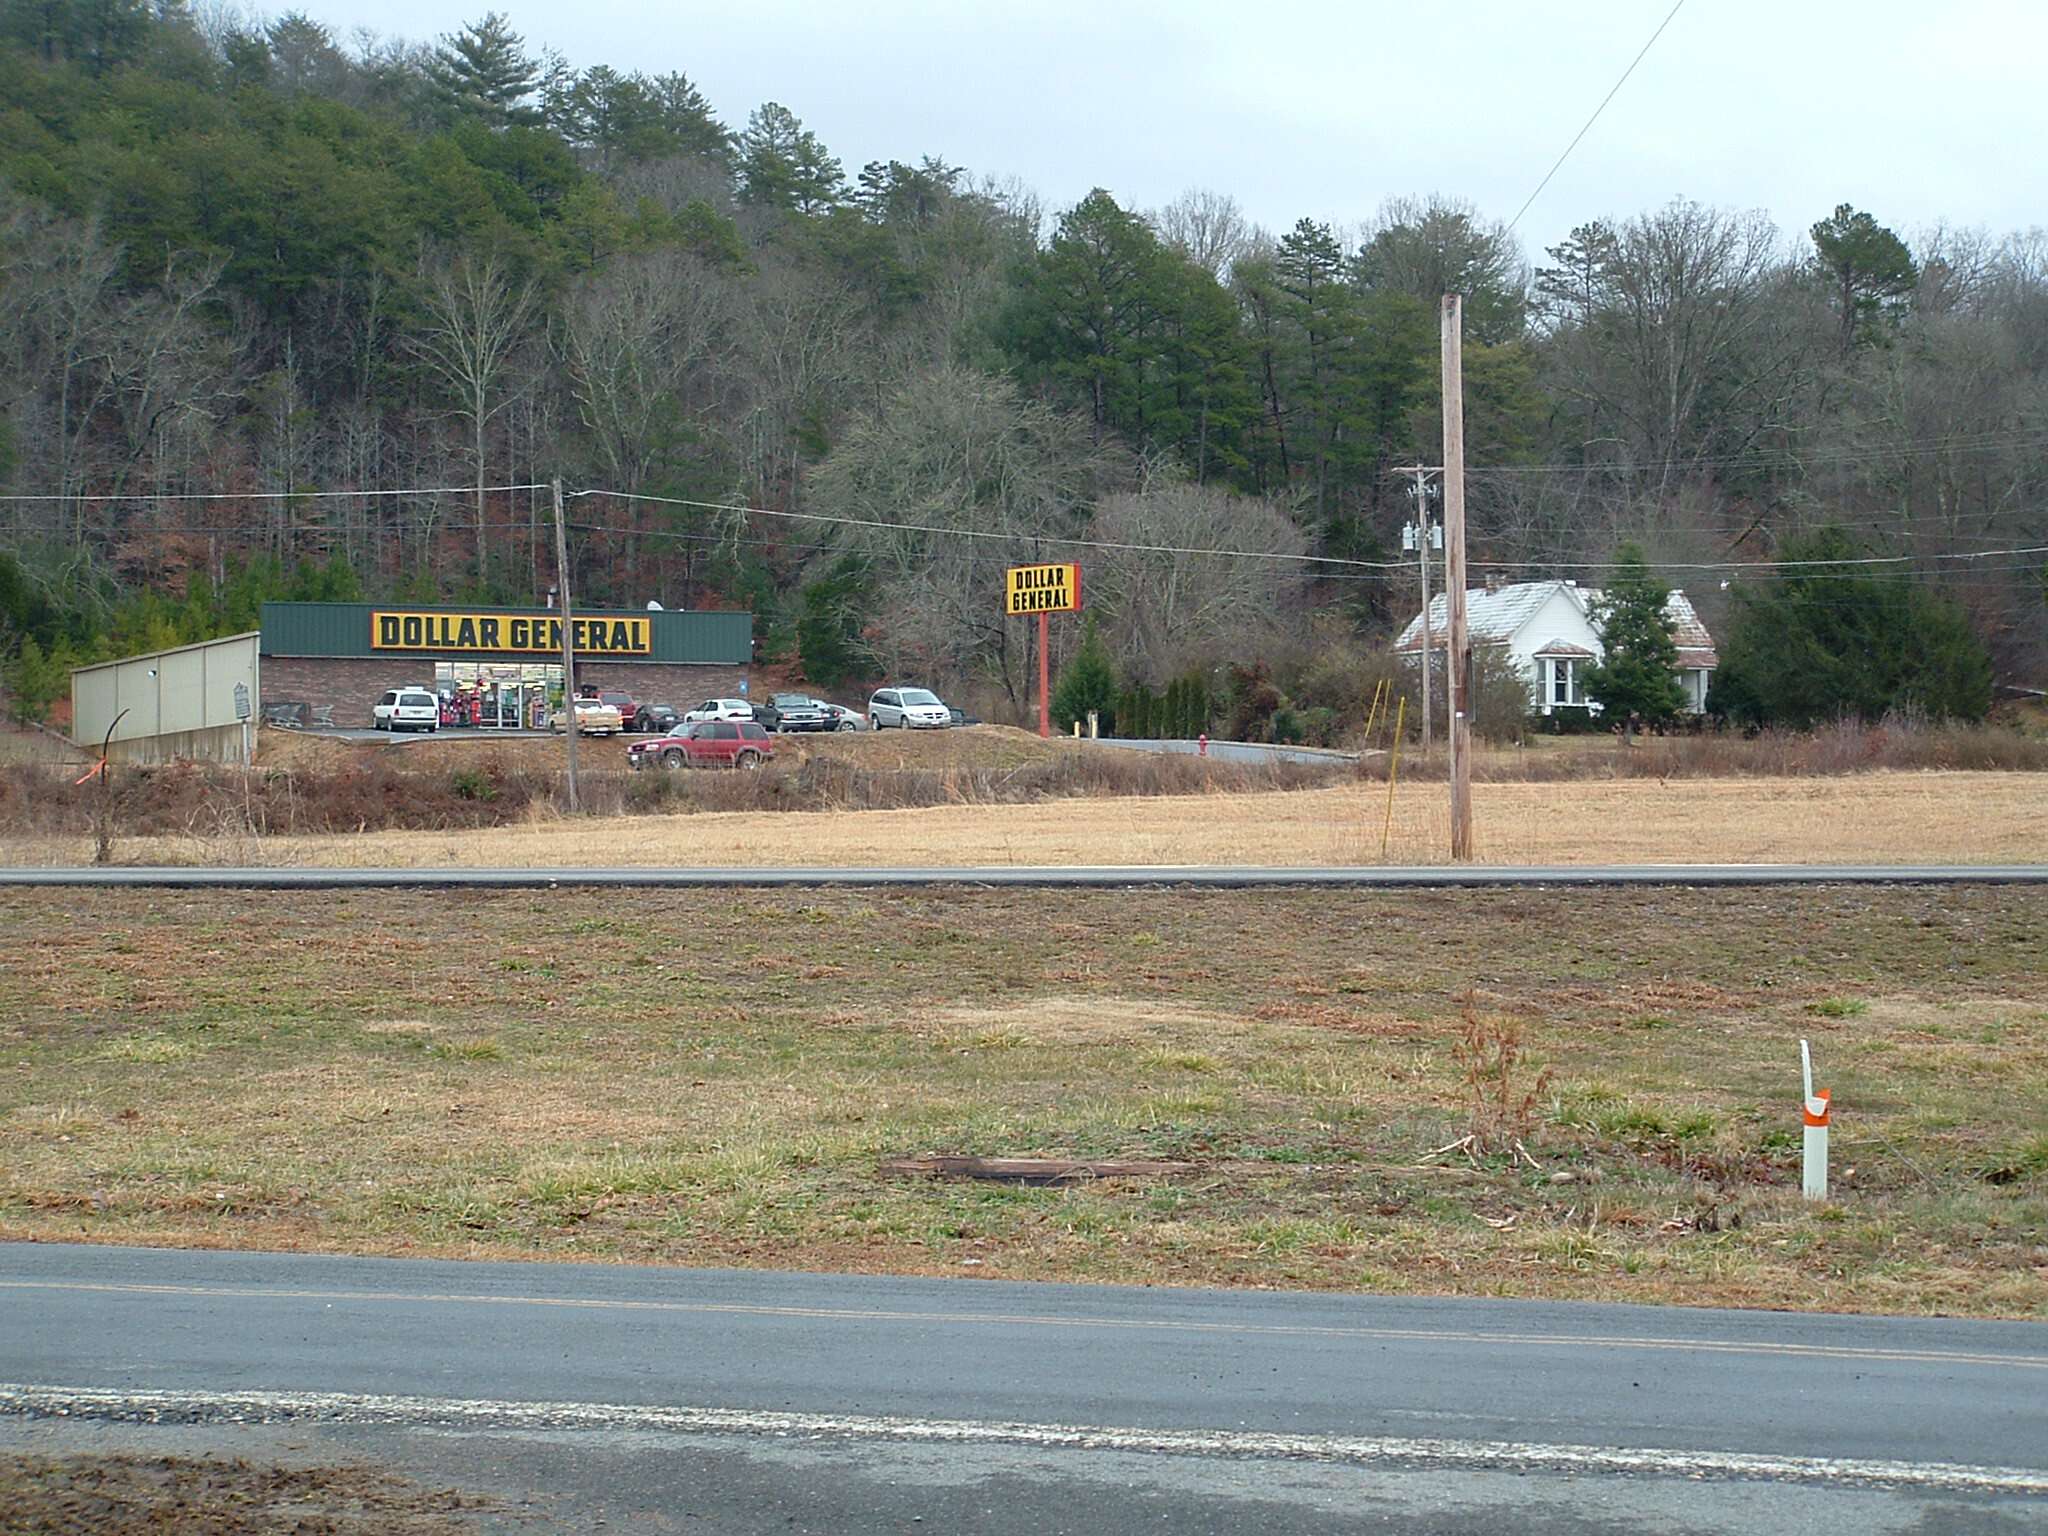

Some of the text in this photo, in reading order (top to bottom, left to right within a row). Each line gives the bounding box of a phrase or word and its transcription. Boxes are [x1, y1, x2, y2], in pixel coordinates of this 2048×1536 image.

[1016, 568, 1064, 589] DOLLAR
[1013, 589, 1068, 610] GENERAL
[380, 615, 501, 648] DOLLAR
